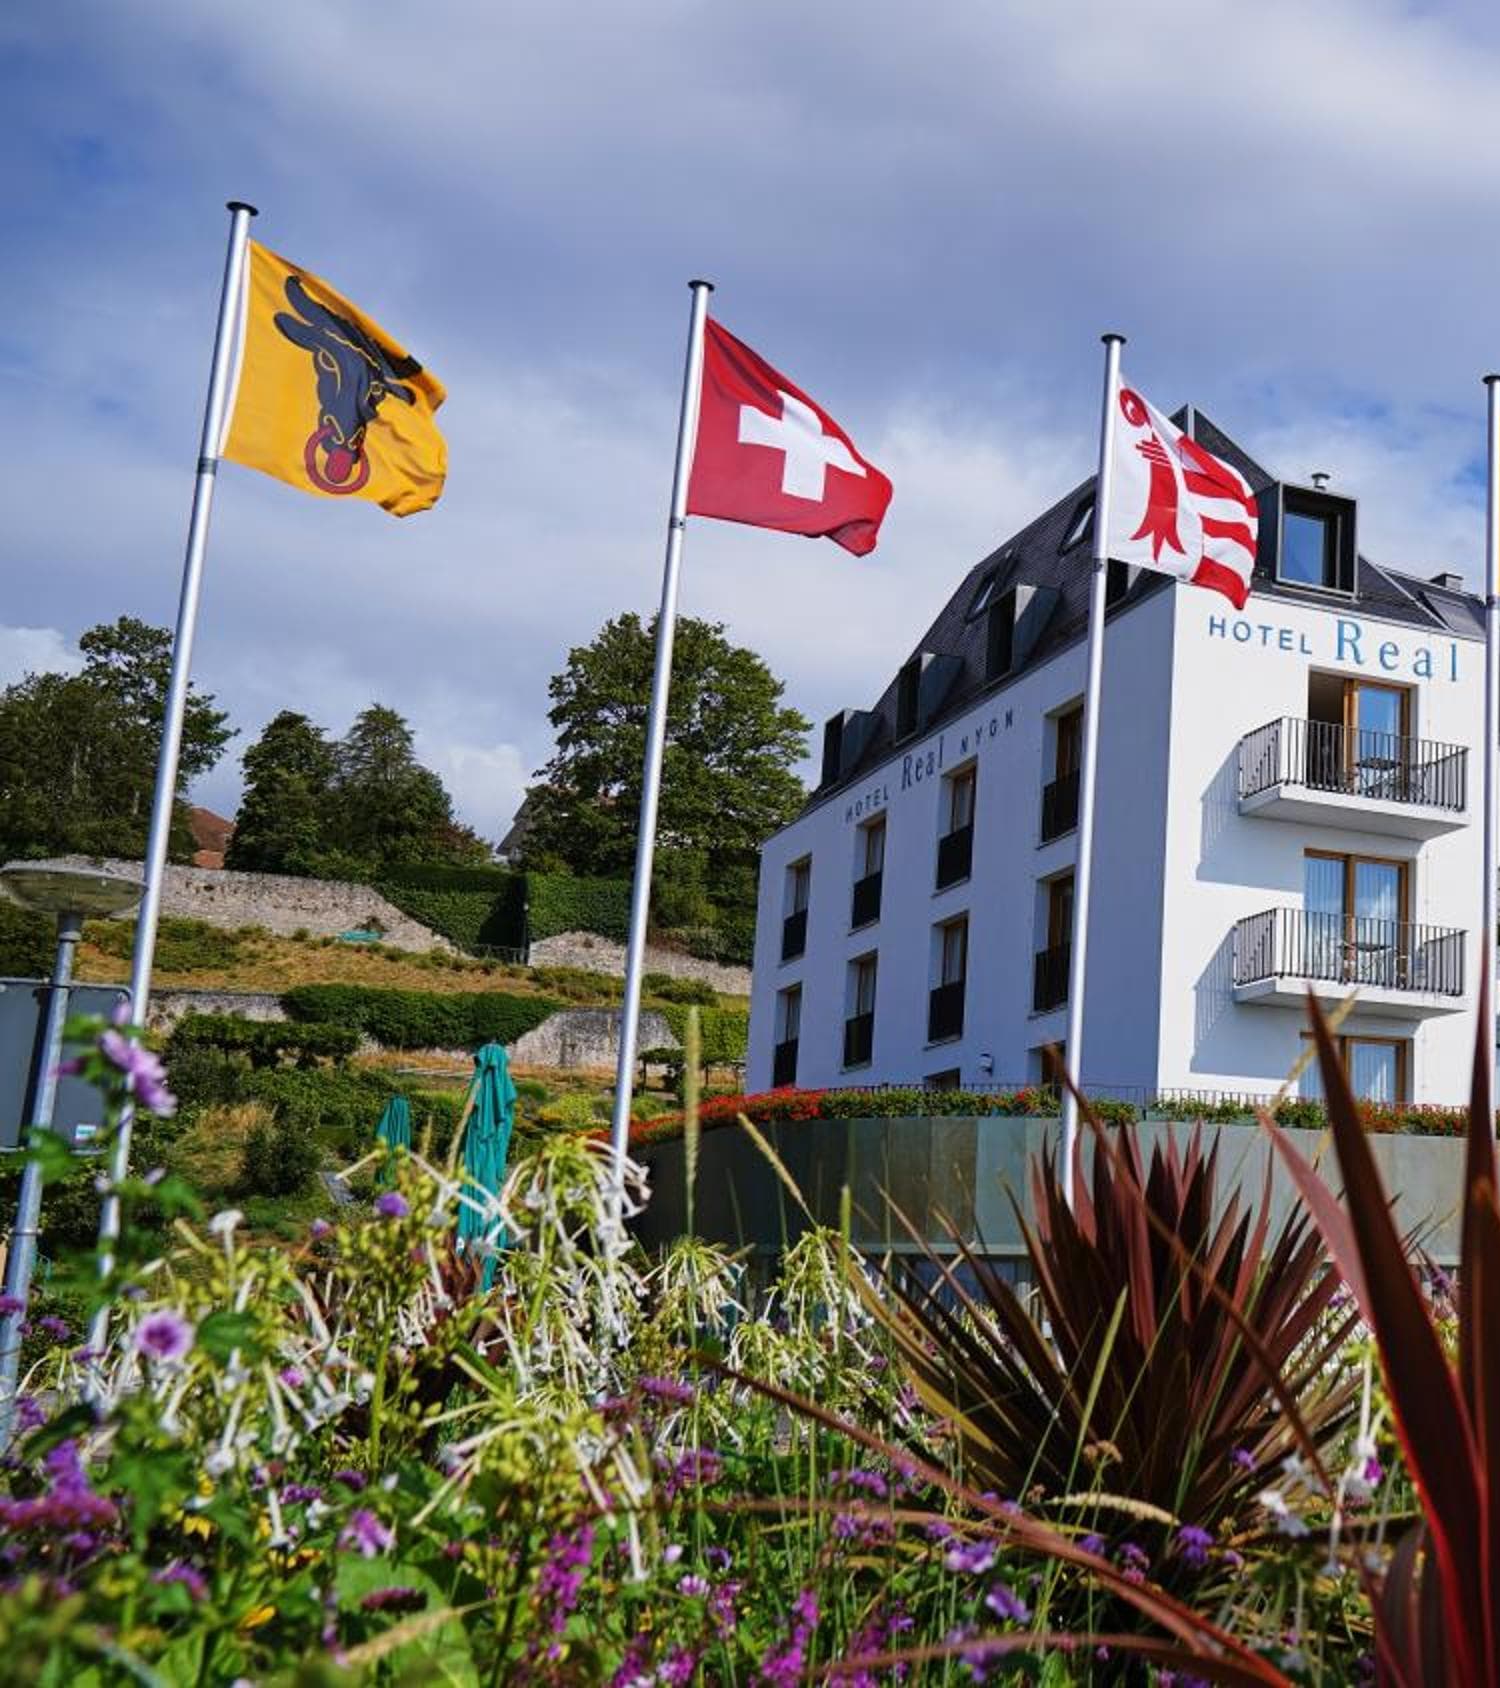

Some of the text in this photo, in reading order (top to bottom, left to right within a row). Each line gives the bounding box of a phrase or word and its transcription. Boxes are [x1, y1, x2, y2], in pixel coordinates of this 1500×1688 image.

[1208, 615, 1458, 682] HOTEL Real
[845, 709, 1014, 823] HOTEL Real NYON
